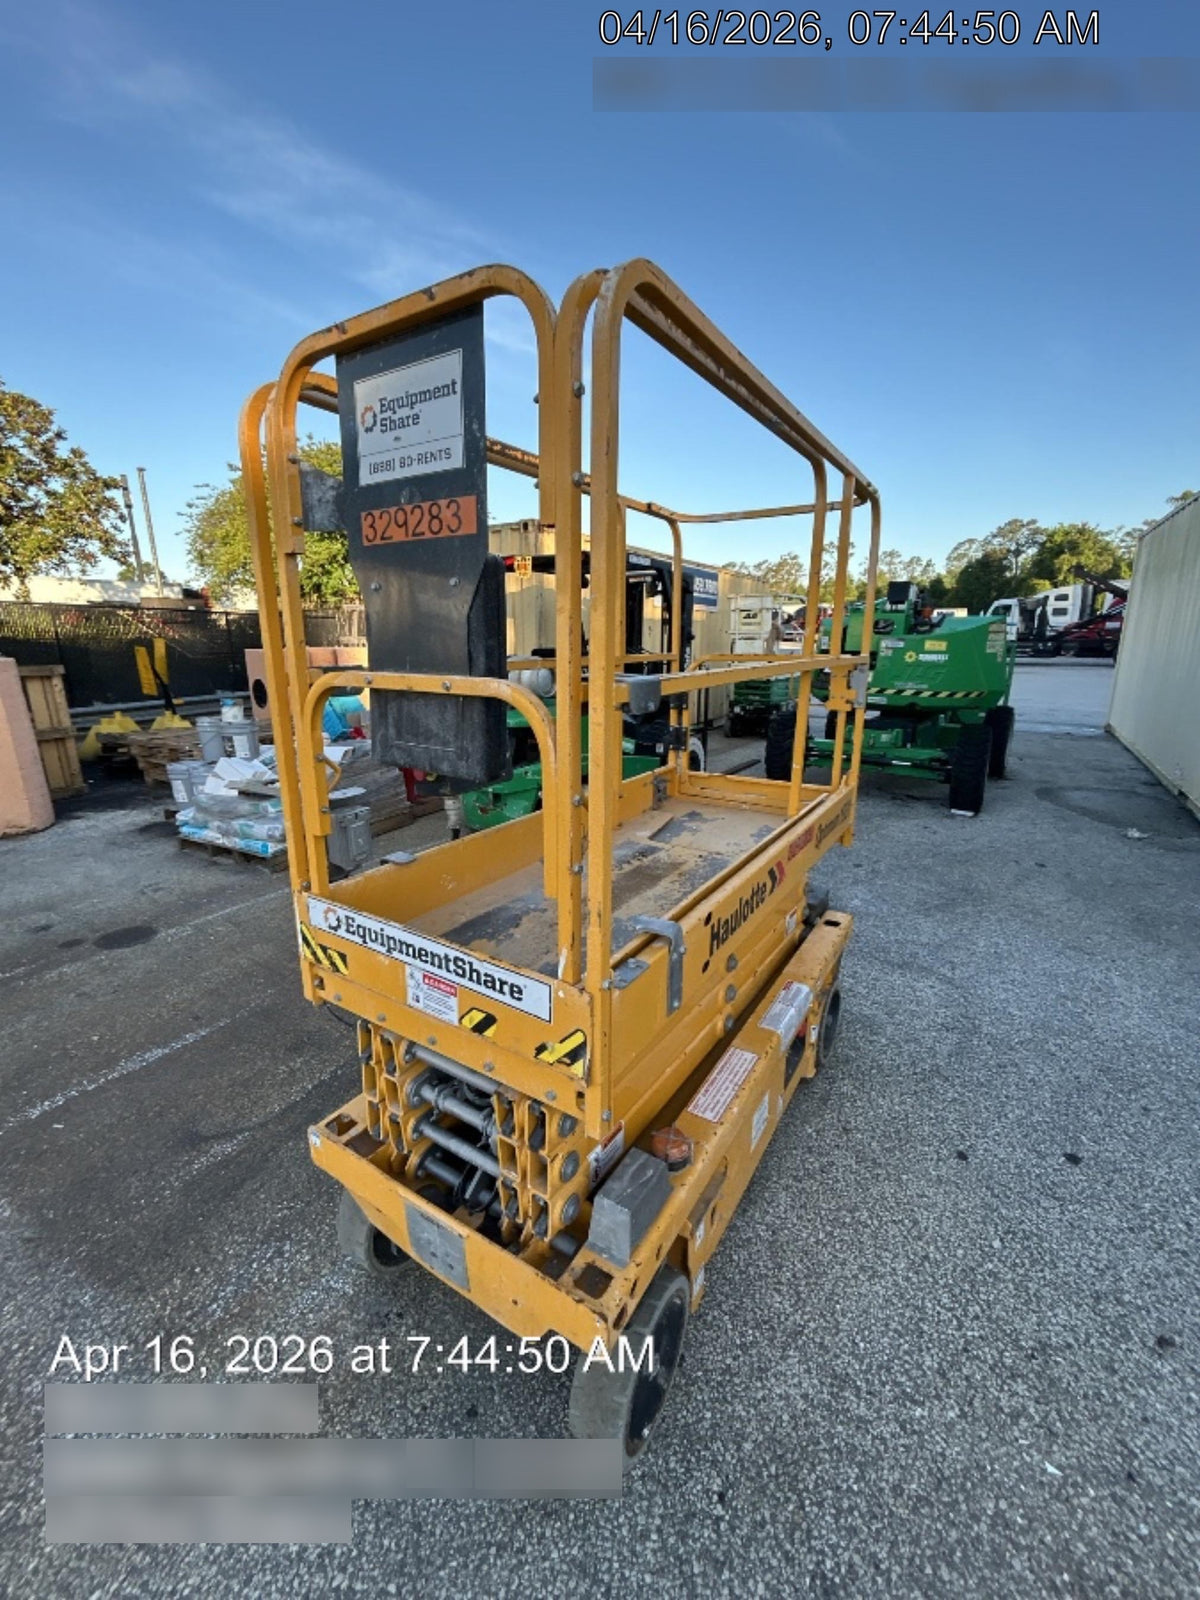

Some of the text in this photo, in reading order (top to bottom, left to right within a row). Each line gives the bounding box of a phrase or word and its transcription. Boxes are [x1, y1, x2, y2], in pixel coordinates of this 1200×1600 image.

[378, 378, 458, 415] Equipment
[380, 413, 420, 434] Share
[363, 499, 462, 543] 329283
[709, 881, 767, 958] Haulotte
[344, 914, 524, 1002] EquipmentShare
